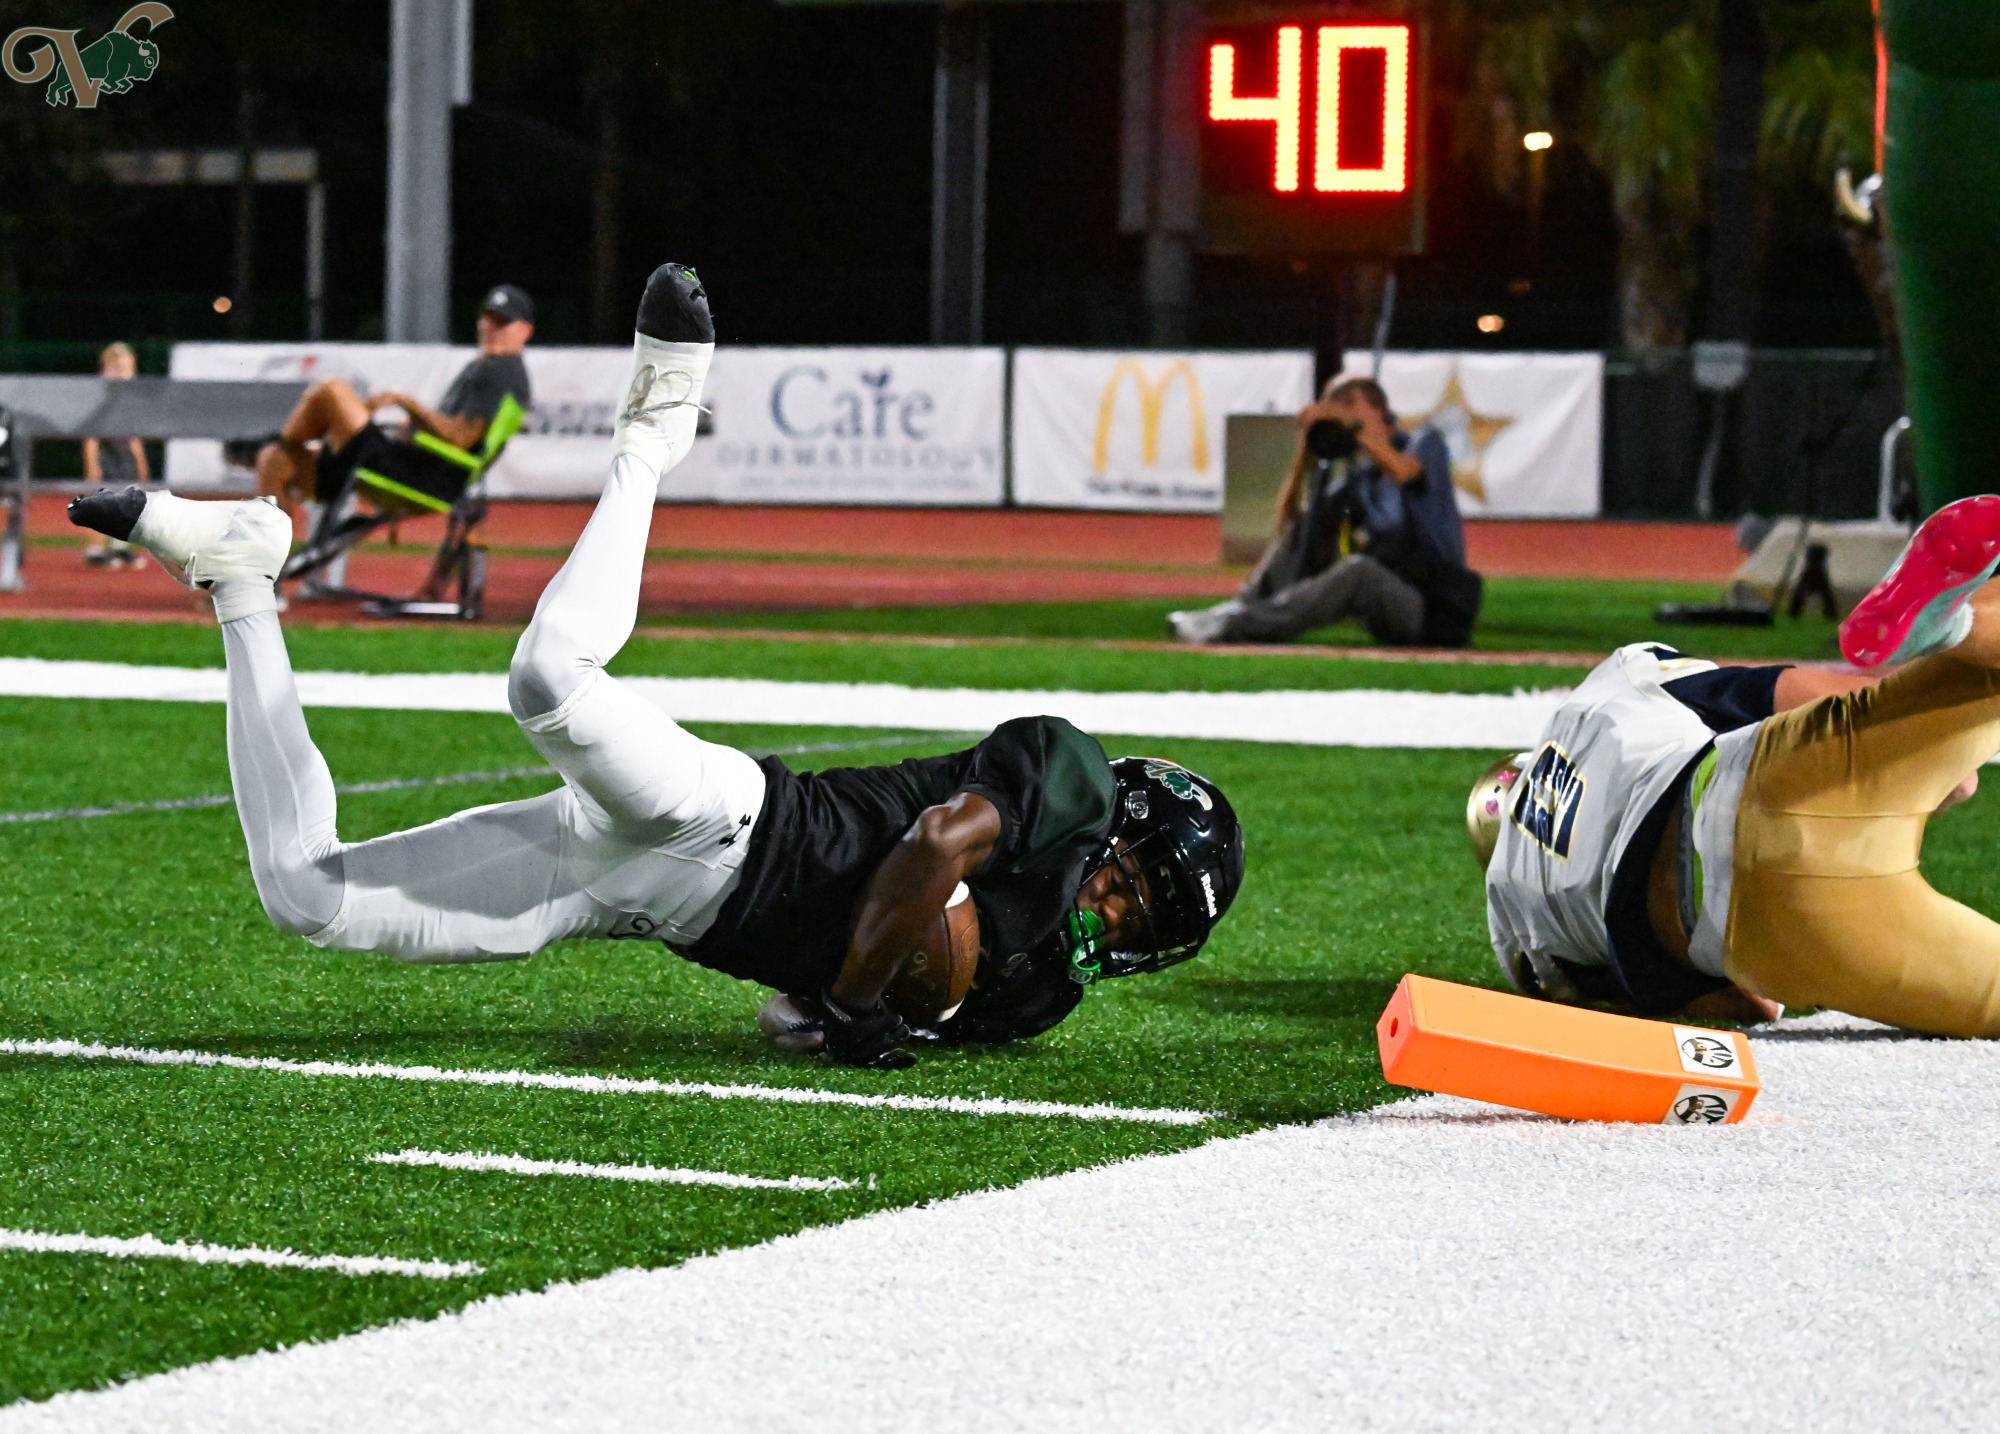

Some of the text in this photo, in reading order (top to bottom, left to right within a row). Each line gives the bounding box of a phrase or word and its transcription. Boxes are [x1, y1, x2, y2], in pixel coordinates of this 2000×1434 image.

[1209, 25, 1409, 192] 40
[770, 364, 935, 440] Care
[1200, 872, 1218, 918] Riddell
